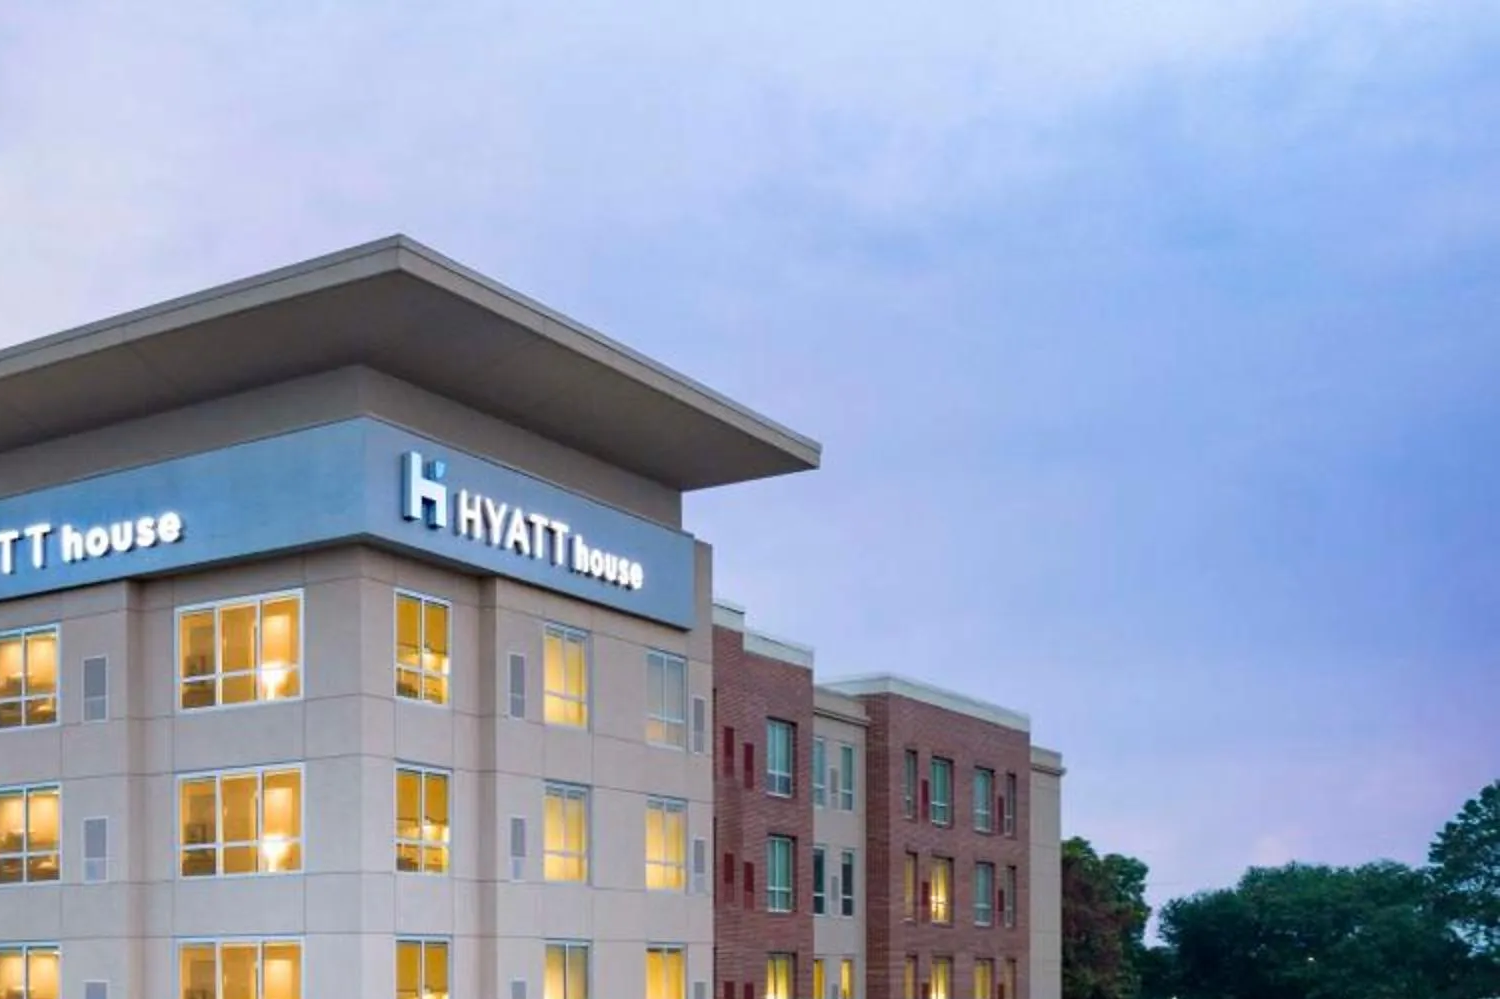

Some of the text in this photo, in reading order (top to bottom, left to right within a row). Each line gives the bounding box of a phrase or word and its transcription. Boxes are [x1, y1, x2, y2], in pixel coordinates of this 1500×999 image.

[61, 511, 183, 563] house
[457, 489, 568, 565] HYATT
[572, 534, 644, 590] house
